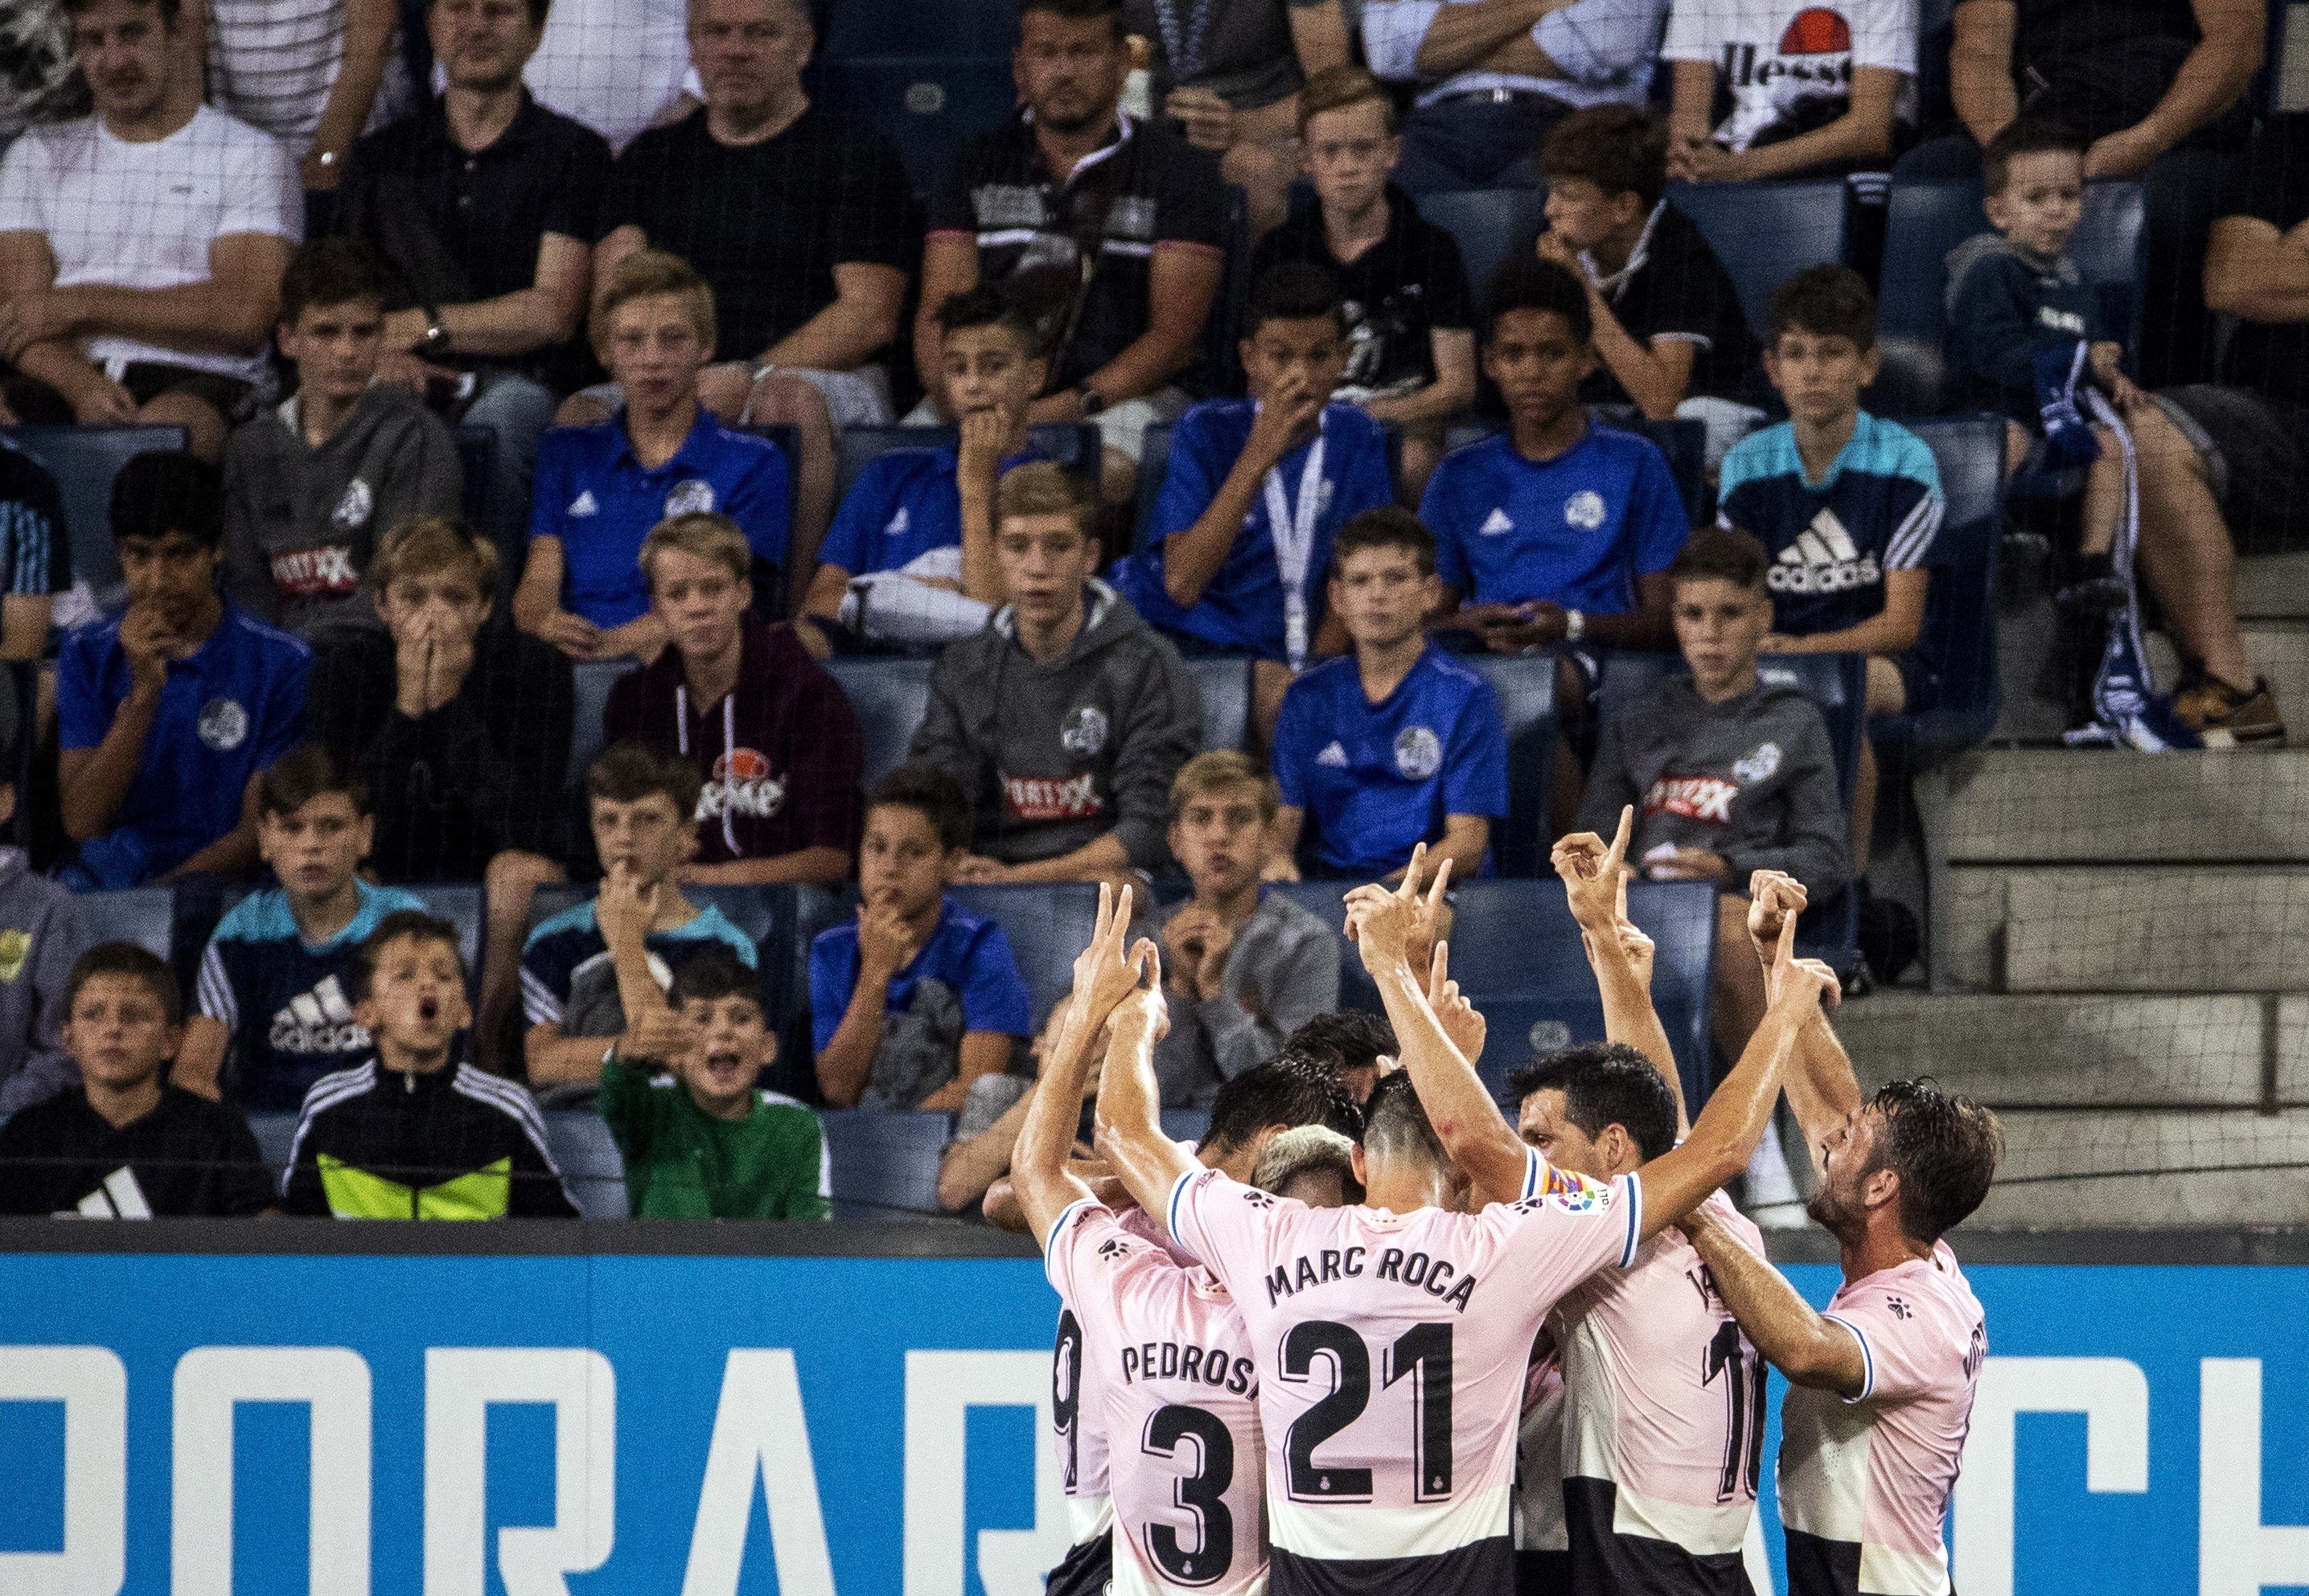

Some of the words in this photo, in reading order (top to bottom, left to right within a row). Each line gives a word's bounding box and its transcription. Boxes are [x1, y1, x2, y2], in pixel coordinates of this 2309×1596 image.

[1767, 552, 1880, 593] adidas
[1264, 1246, 1366, 1310] MARC
[1376, 1248, 1477, 1314] ROCA
[1277, 1319, 1453, 1504] 21
[1141, 1404, 1235, 1588] 3
